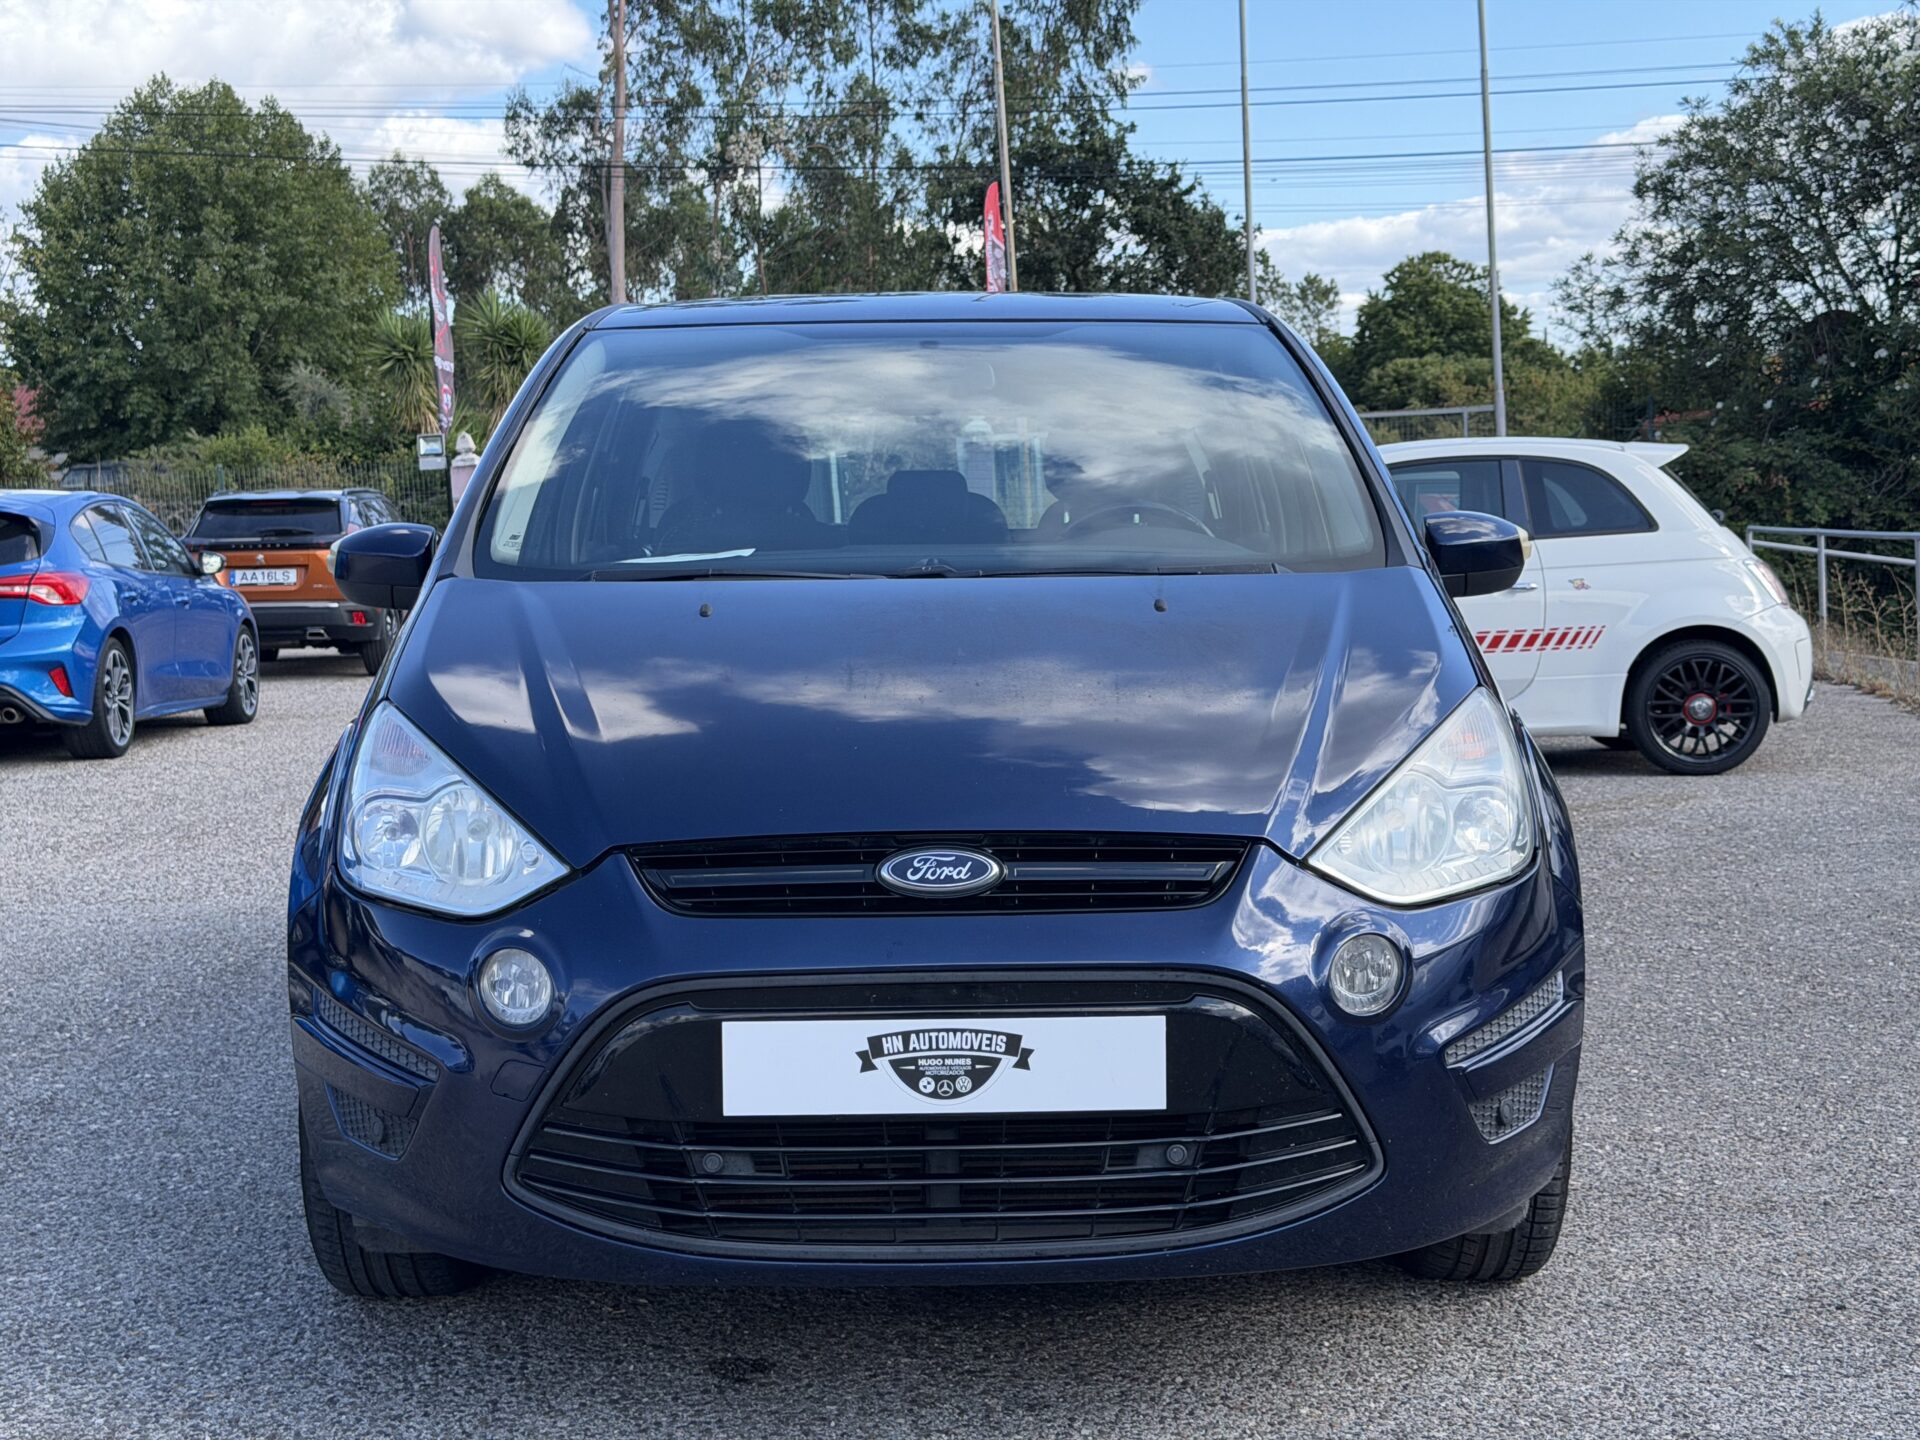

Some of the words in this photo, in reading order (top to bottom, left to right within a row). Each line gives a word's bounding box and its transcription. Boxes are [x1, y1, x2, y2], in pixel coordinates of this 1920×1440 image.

[906, 855, 972, 881] Ford
[881, 1035, 904, 1055] HN
[909, 1030, 1008, 1053] AUTOMÓVEIS
[917, 1058, 943, 1066] HUGO
[944, 1058, 972, 1066] NUNES
